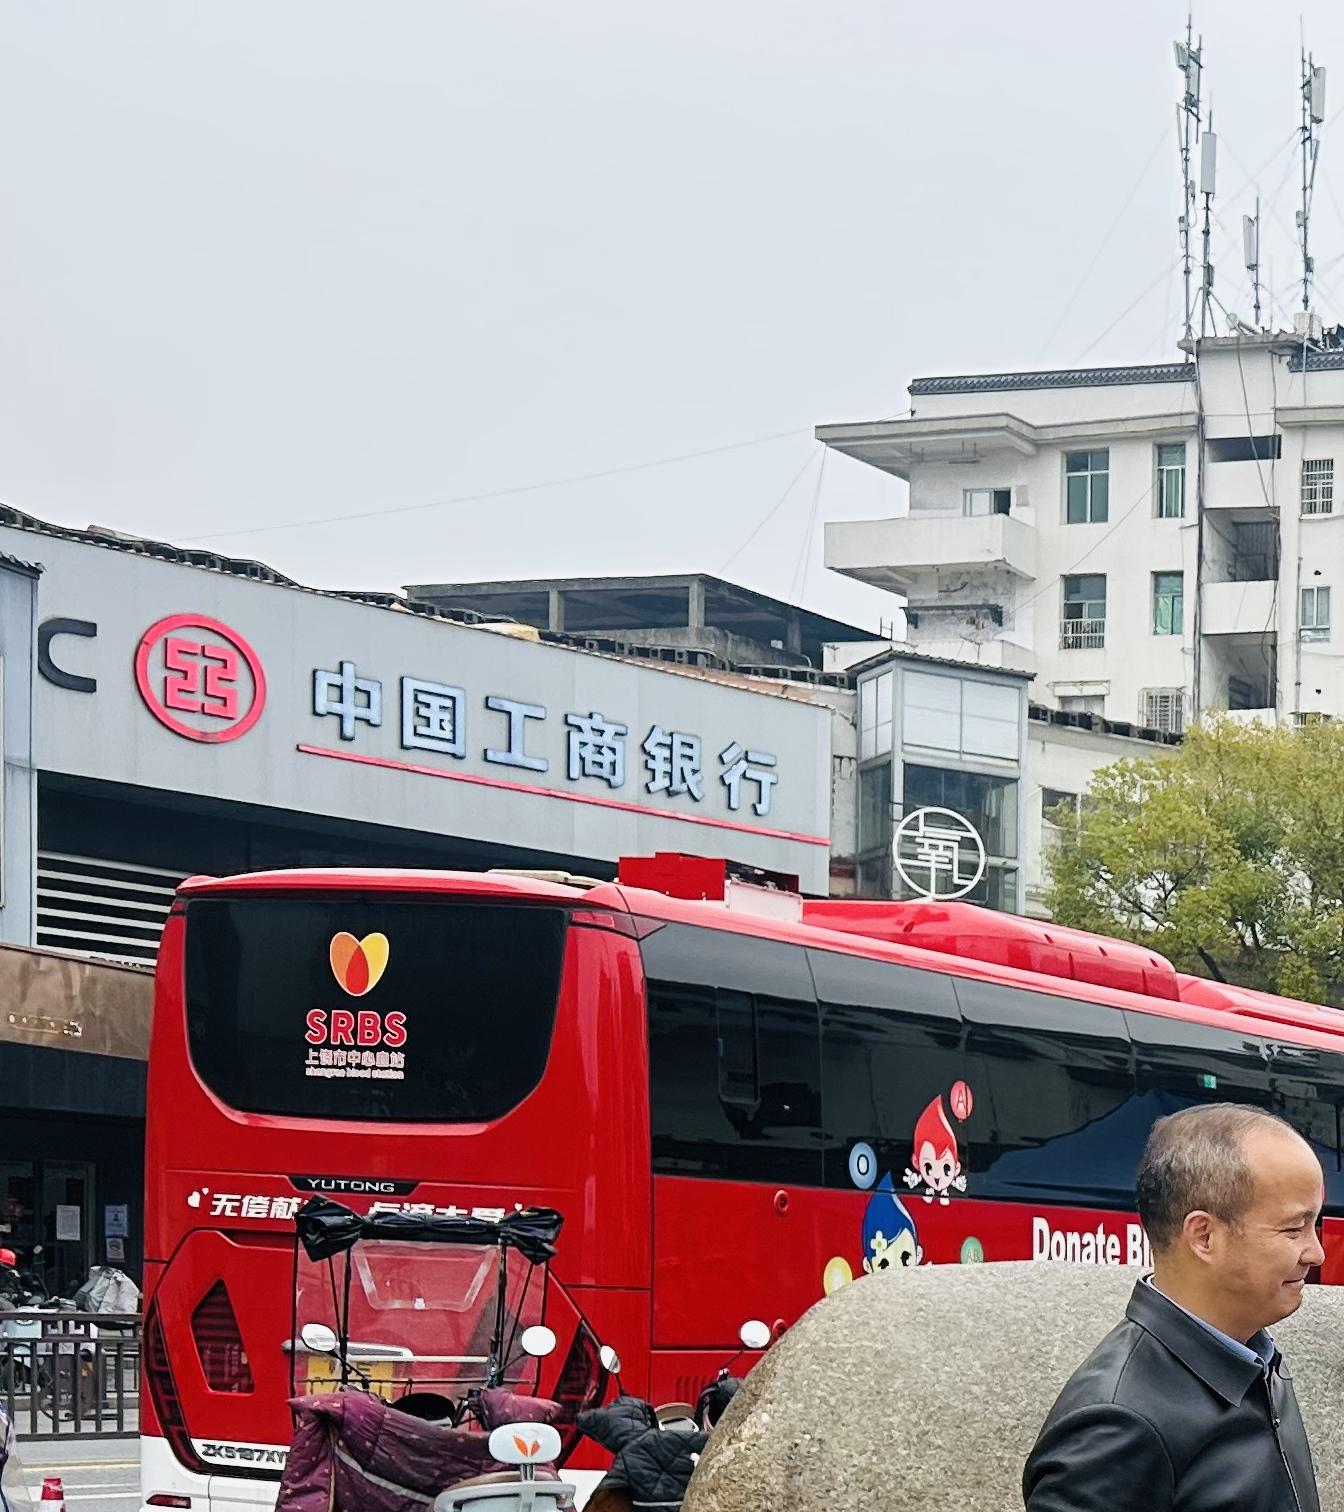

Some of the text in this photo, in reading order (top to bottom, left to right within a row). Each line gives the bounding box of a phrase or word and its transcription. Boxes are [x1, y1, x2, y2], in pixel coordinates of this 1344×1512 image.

[312, 660, 780, 816] 中国工商银行
[305, 1008, 408, 1047] SRBS
[307, 1178, 395, 1192] YUTONG
[1032, 1216, 1121, 1265] Donate
